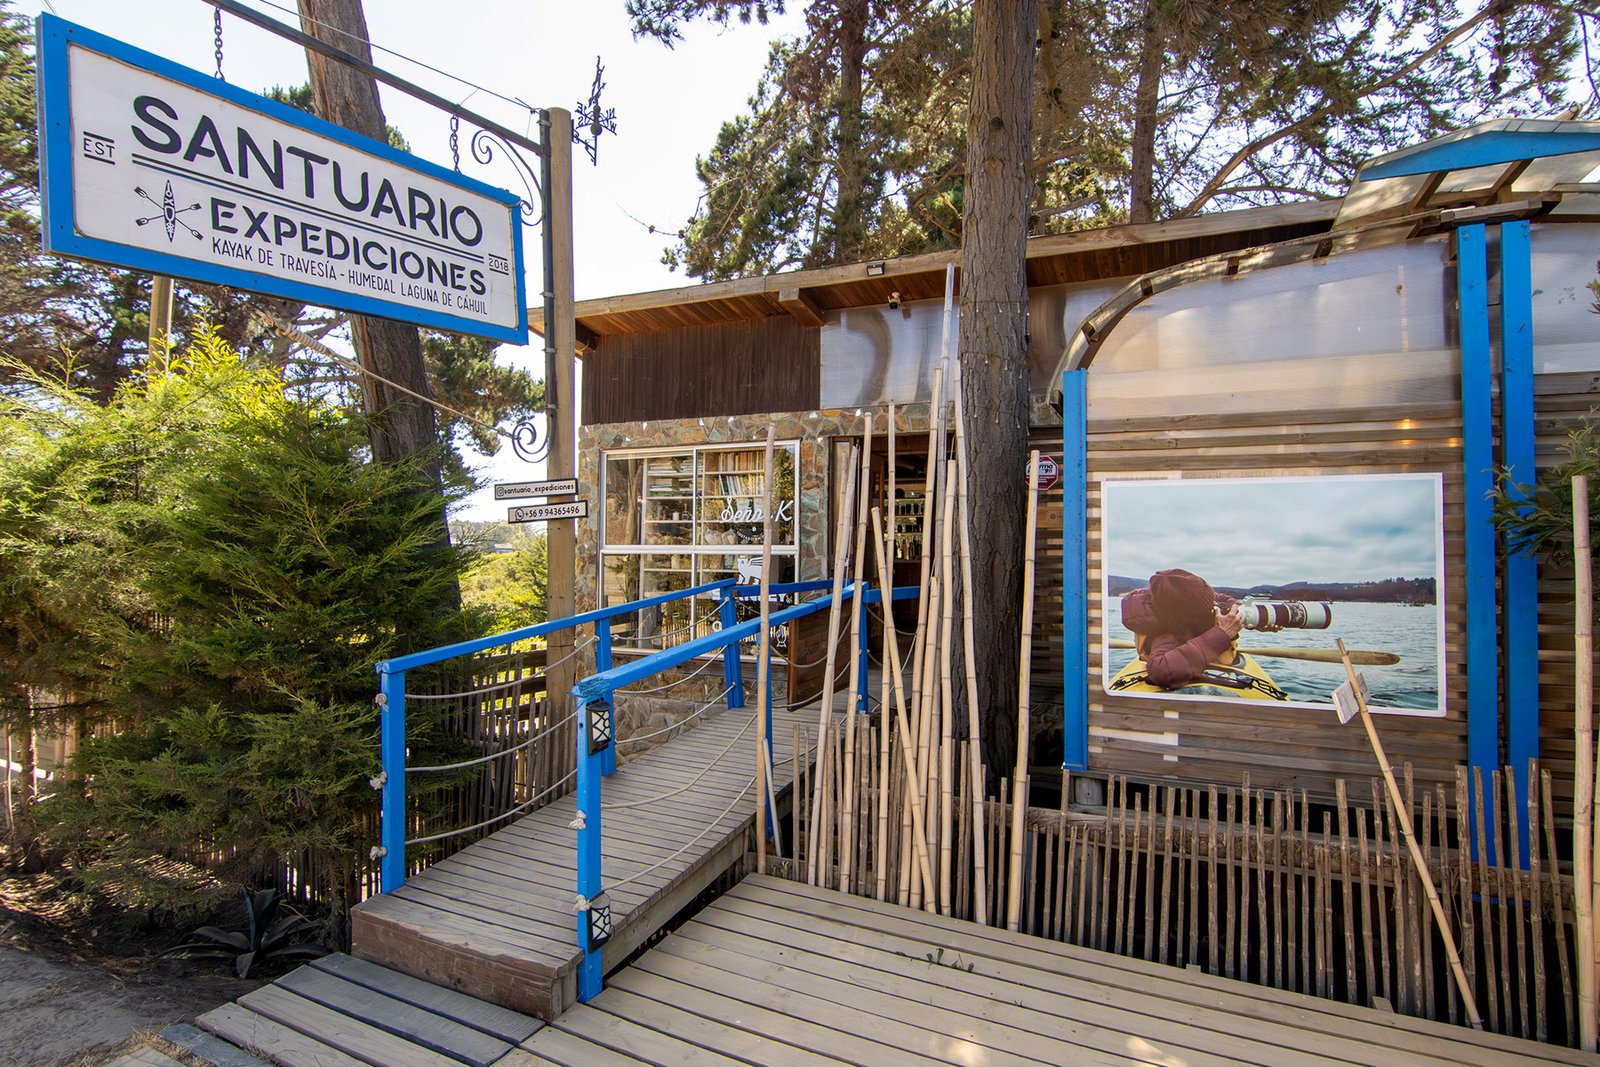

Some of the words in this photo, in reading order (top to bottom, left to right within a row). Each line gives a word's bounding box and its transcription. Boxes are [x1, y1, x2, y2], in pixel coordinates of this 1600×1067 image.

[83, 137, 115, 158] EST
[131, 95, 483, 247] SANTUARIO
[210, 196, 487, 296] EXPEDICIONES
[212, 236, 253, 262] KAYAK
[258, 247, 274, 267] DE
[279, 252, 337, 281] TRAVESÍA
[348, 269, 396, 295] HUMEDAL
[400, 281, 439, 304] LAGUNA
[441, 291, 453, 308] DE
[457, 295, 487, 315] CÁHUIL
[488, 258, 509, 272] 2018
[504, 484, 574, 494] santuario_expediciones
[525, 509, 537, 518] +56
[539, 508, 544, 517] 9
[545, 505, 580, 516] 94365496
[720, 495, 774, 523] Seño
[775, 500, 793, 521] K
